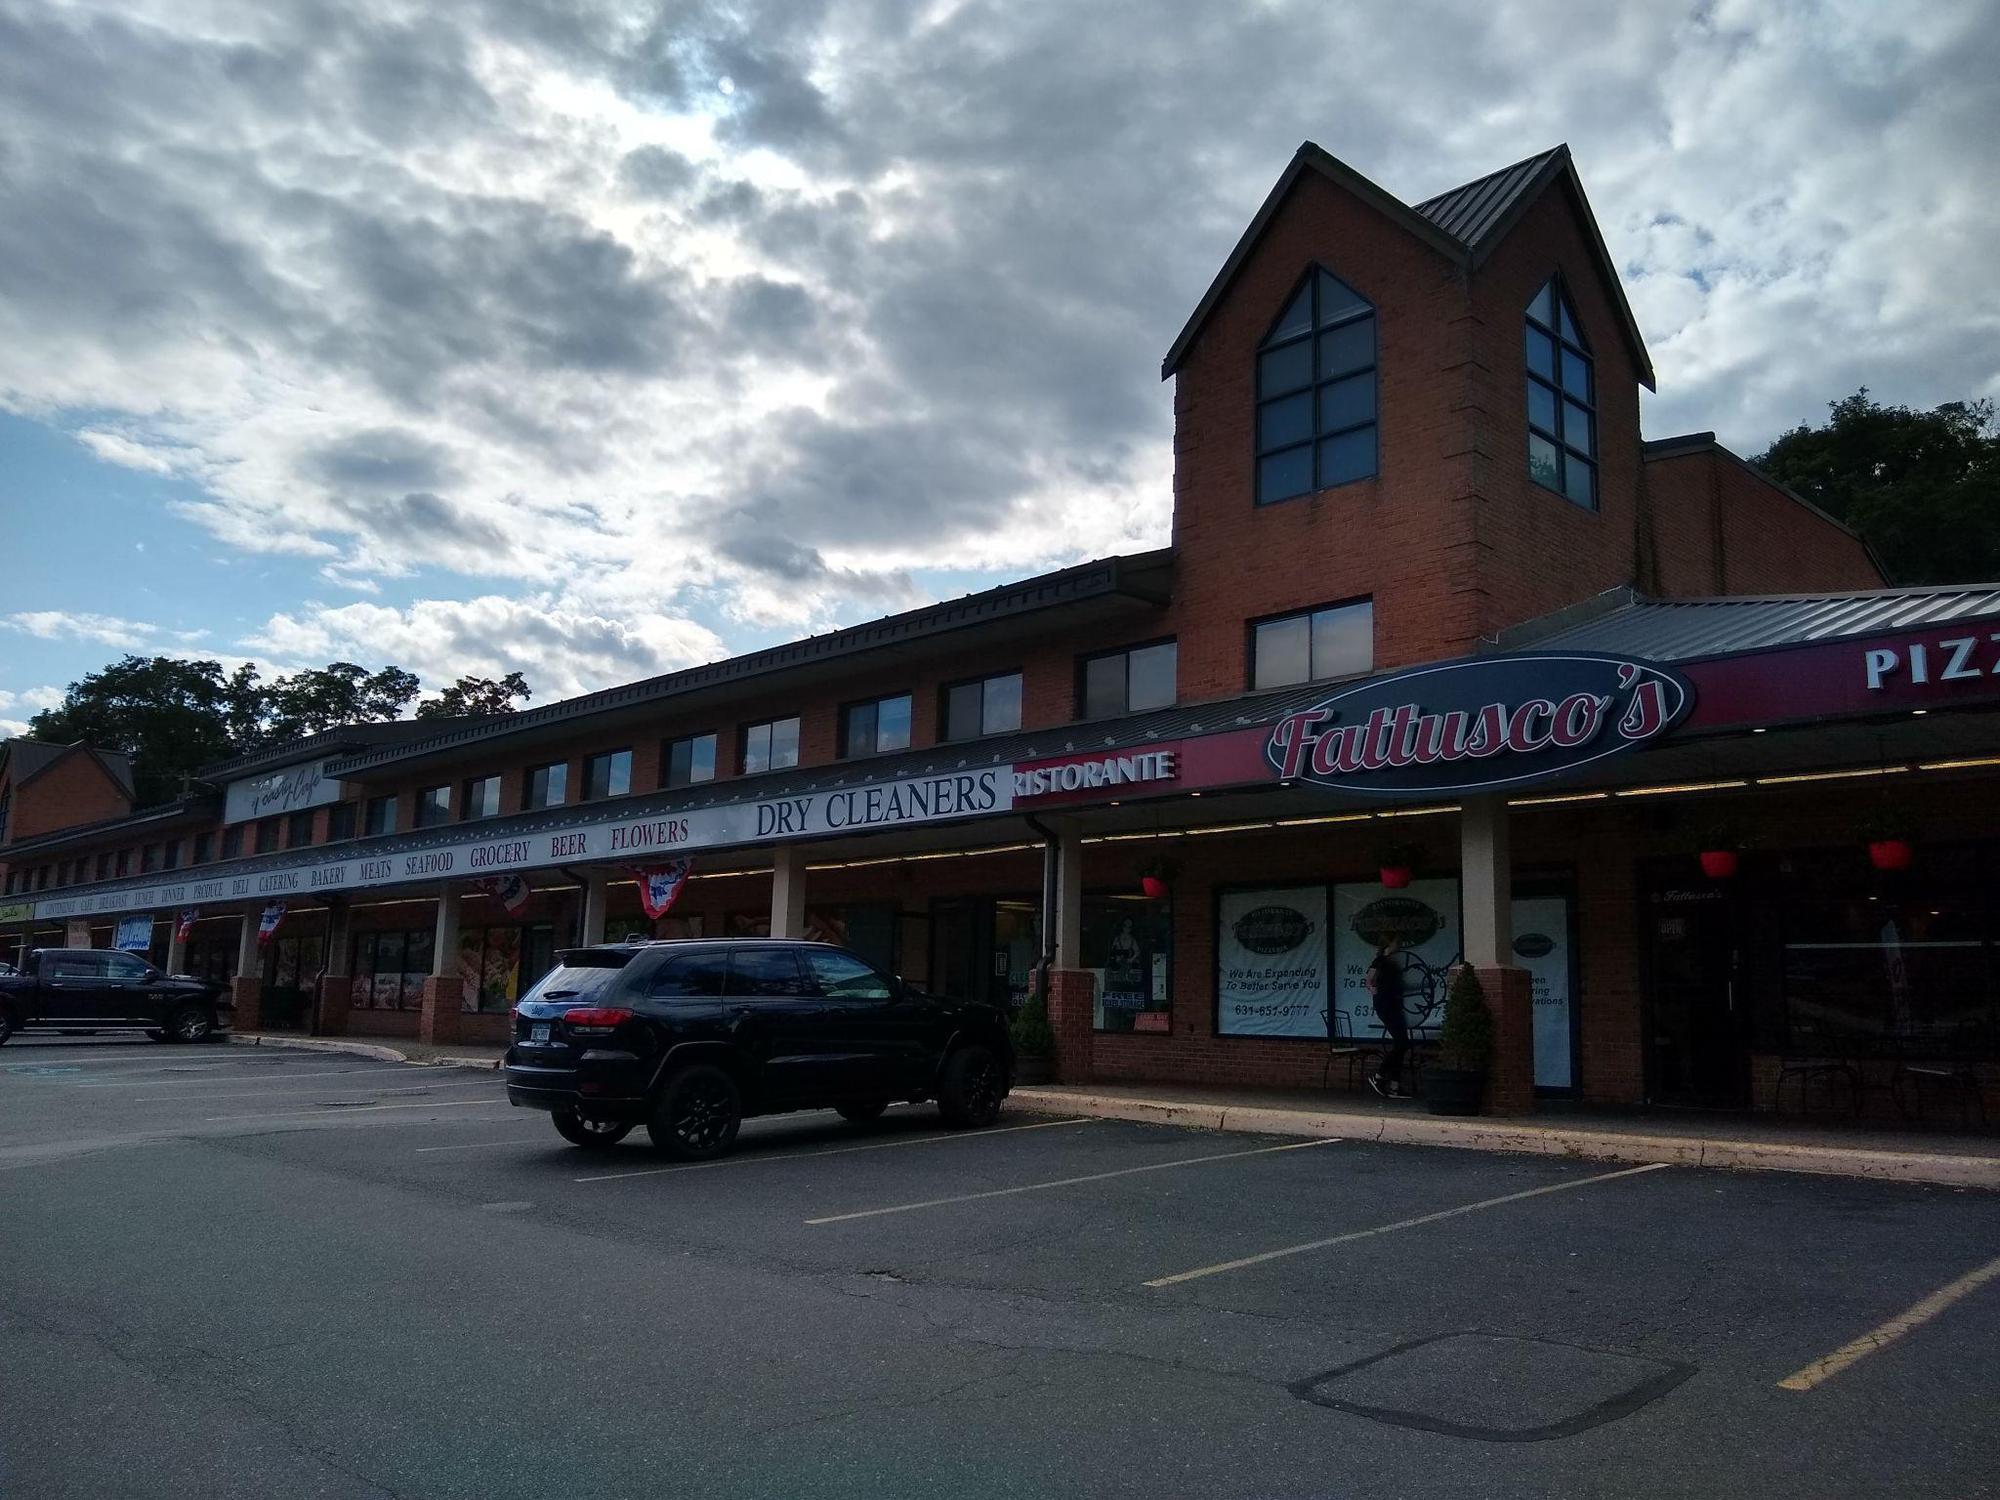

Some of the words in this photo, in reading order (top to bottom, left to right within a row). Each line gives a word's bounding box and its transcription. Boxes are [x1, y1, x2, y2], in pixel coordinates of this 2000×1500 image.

[1865, 633, 2000, 689] PIZ
[1274, 662, 1668, 780] Fattusco's
[1012, 751, 1175, 797] RISTORANTE
[756, 797, 813, 837] DRY
[826, 771, 996, 828] CLEANERS
[161, 887, 185, 902] DINNER
[193, 881, 224, 898] PRODUCE
[232, 878, 249, 895] DELI
[258, 872, 299, 892] CATERING
[310, 866, 346, 887] BAKERY
[359, 859, 392, 880] MEATS
[405, 851, 454, 876] SEAFOOD
[470, 841, 531, 868] GROCERY
[551, 832, 587, 858] BEER
[611, 818, 689, 850] FLOWERS
[1226, 981, 1237, 990] To
[1271, 981, 1299, 991] Serve
[1302, 979, 1321, 989] You
[1229, 969, 1243, 978] We
[1246, 968, 1262, 978] Are
[1265, 967, 1316, 980] Expanding
